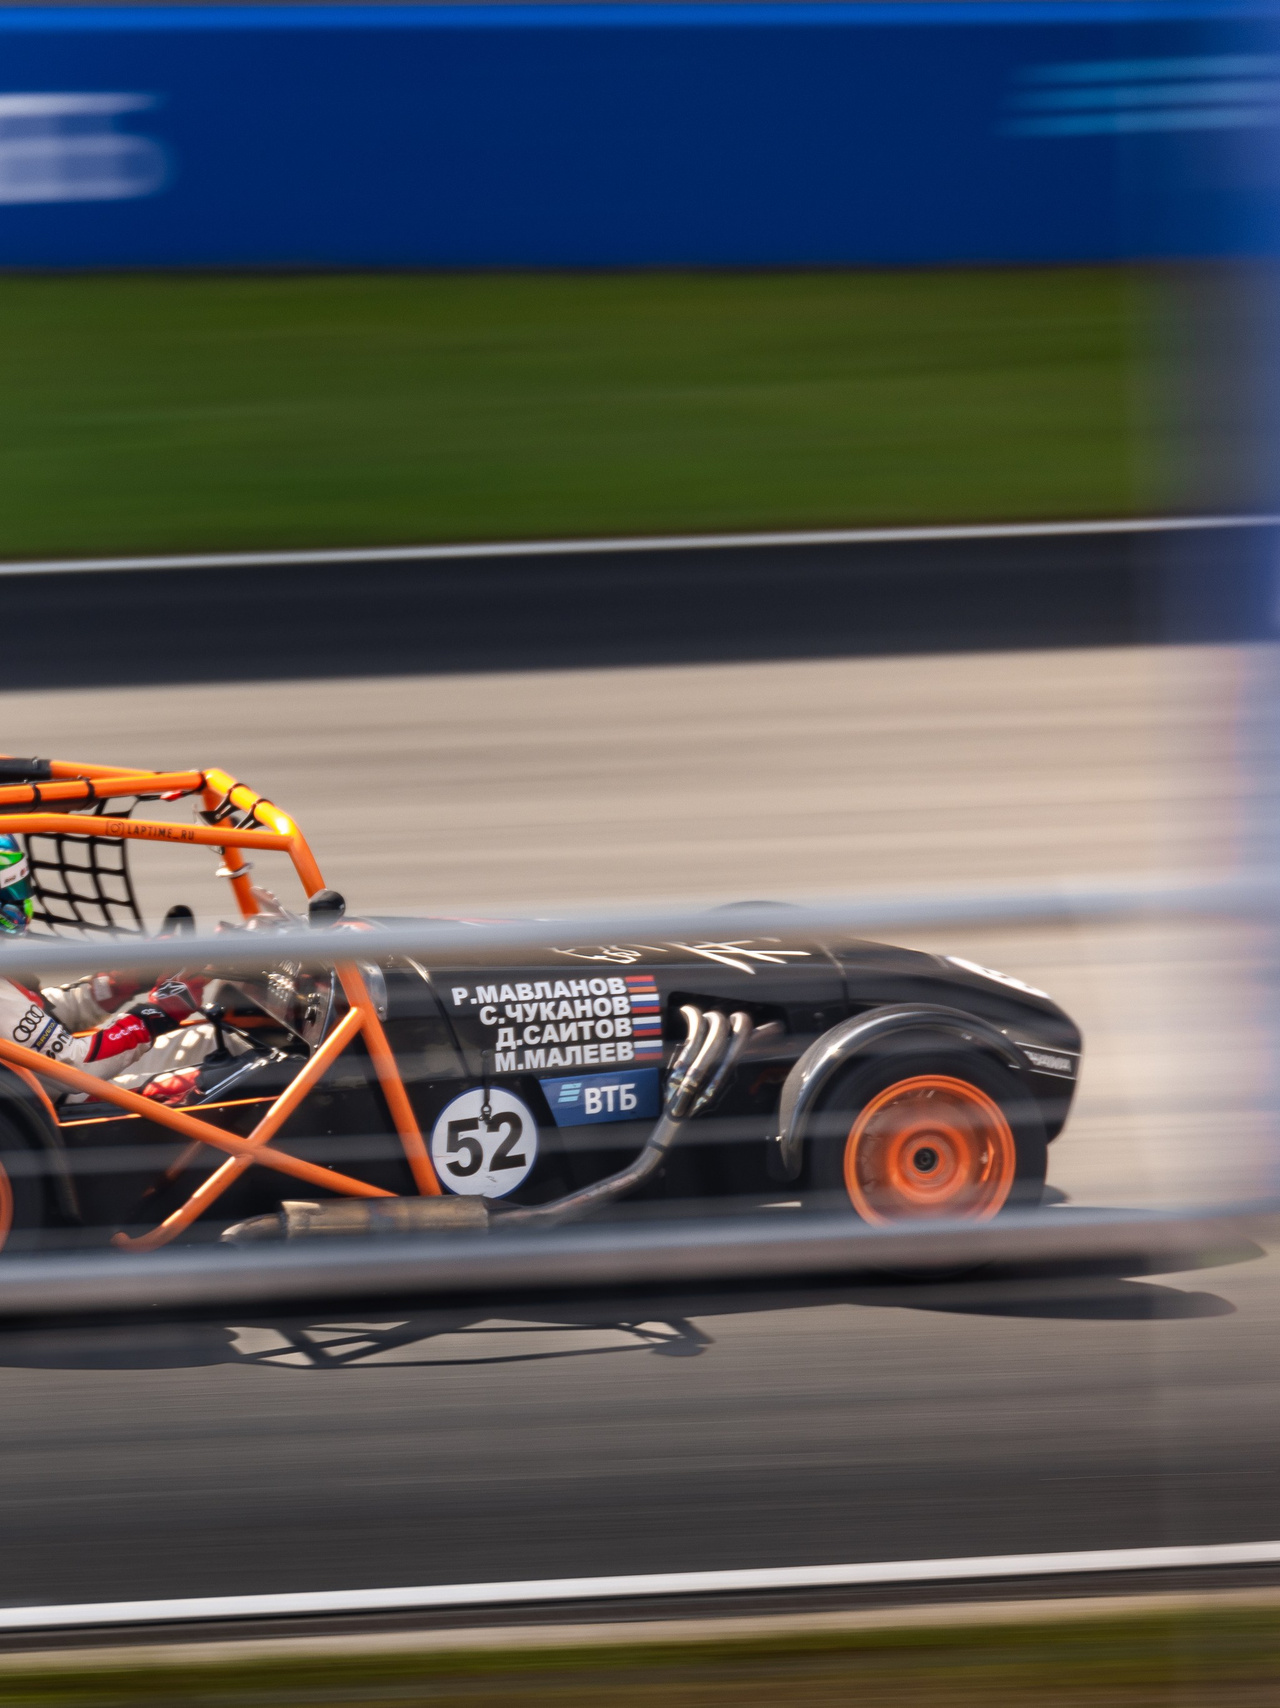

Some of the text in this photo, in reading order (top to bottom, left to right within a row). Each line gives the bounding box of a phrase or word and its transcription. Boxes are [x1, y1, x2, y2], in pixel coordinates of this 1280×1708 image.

[451, 977, 627, 1006] Р.МАВЛАНОВ
[479, 996, 631, 1026] С.ЧУКАНОВ
[495, 1018, 633, 1051] Д.САИТОВ
[494, 1042, 634, 1073] М.МАЛЕЕВ
[584, 1083, 637, 1115] ВТБ
[445, 1110, 527, 1178] 52
